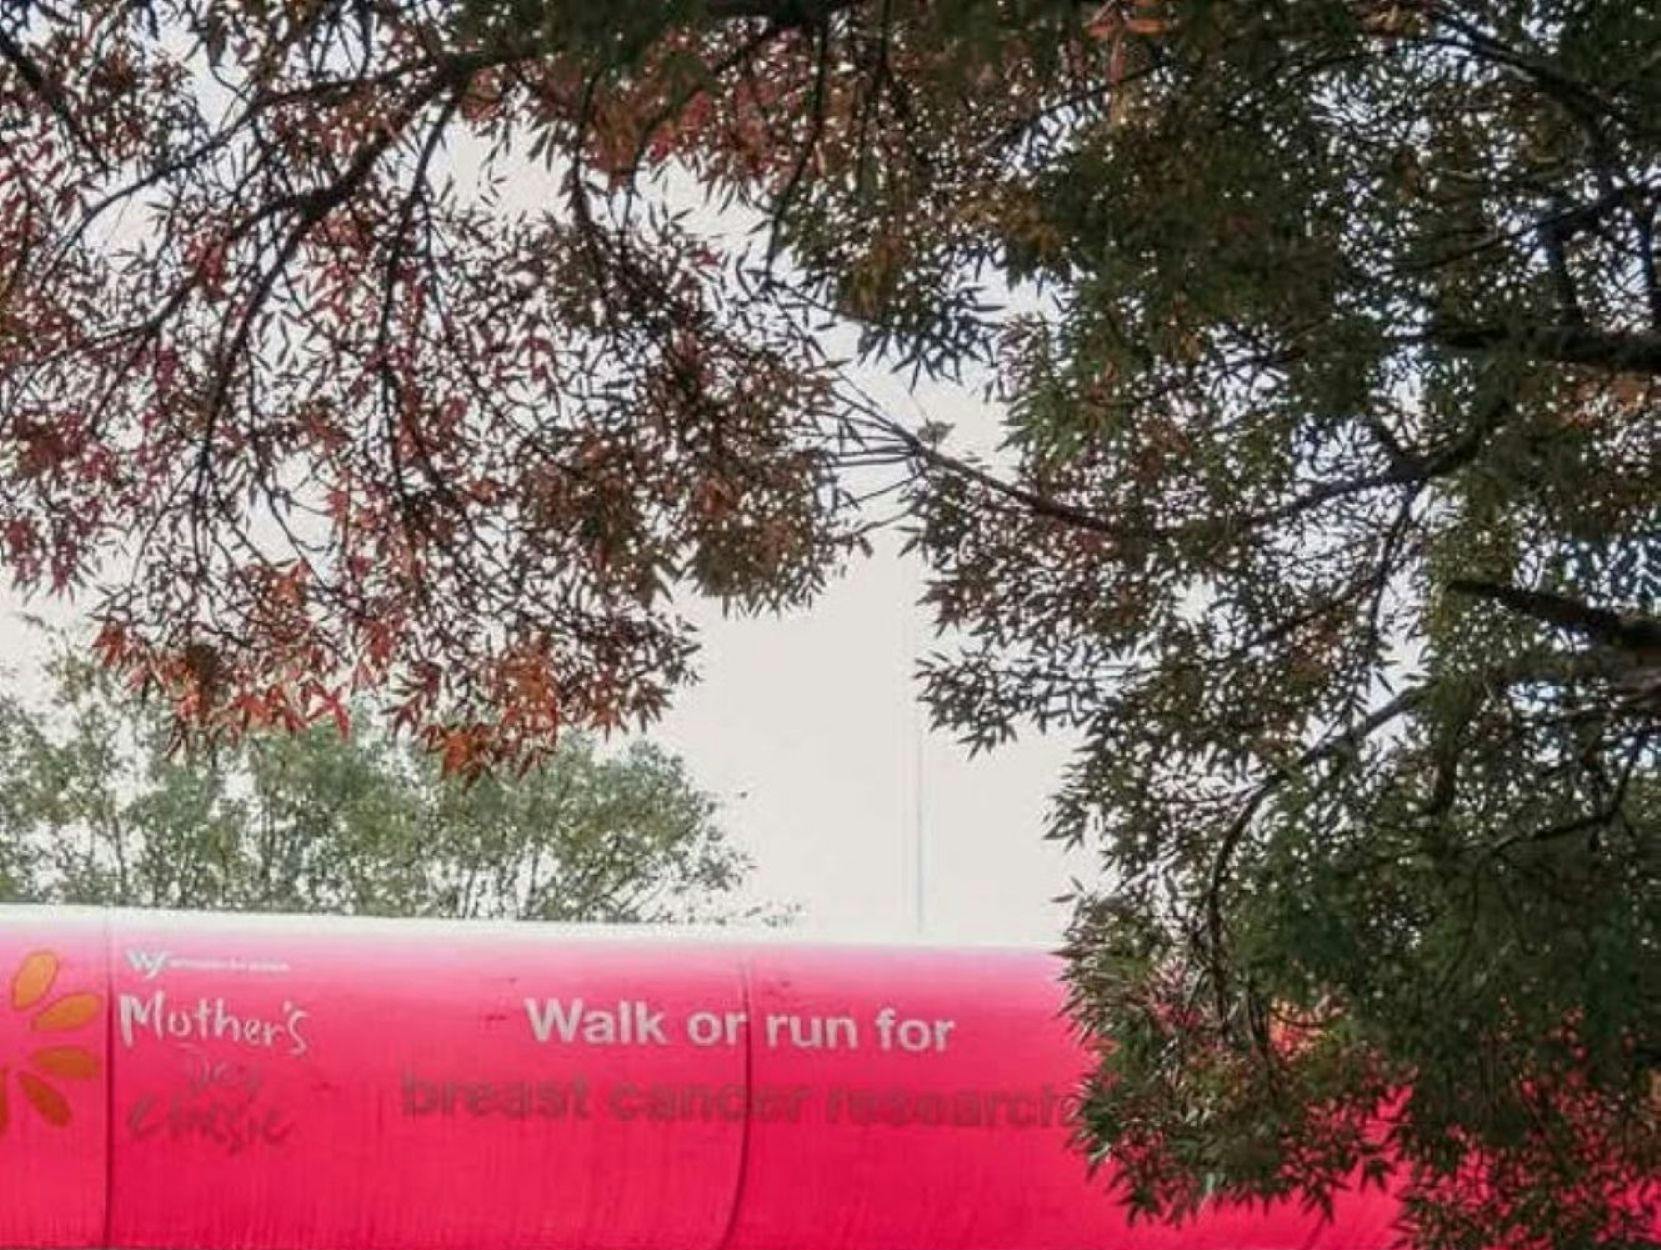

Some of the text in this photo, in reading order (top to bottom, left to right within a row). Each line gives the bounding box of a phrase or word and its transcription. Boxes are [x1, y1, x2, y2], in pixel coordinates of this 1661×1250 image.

[119, 989, 309, 1056] Mother's
[524, 999, 955, 1052] Walk or run for
[401, 1073, 590, 1120] breast
[608, 1079, 813, 1125] cancer
